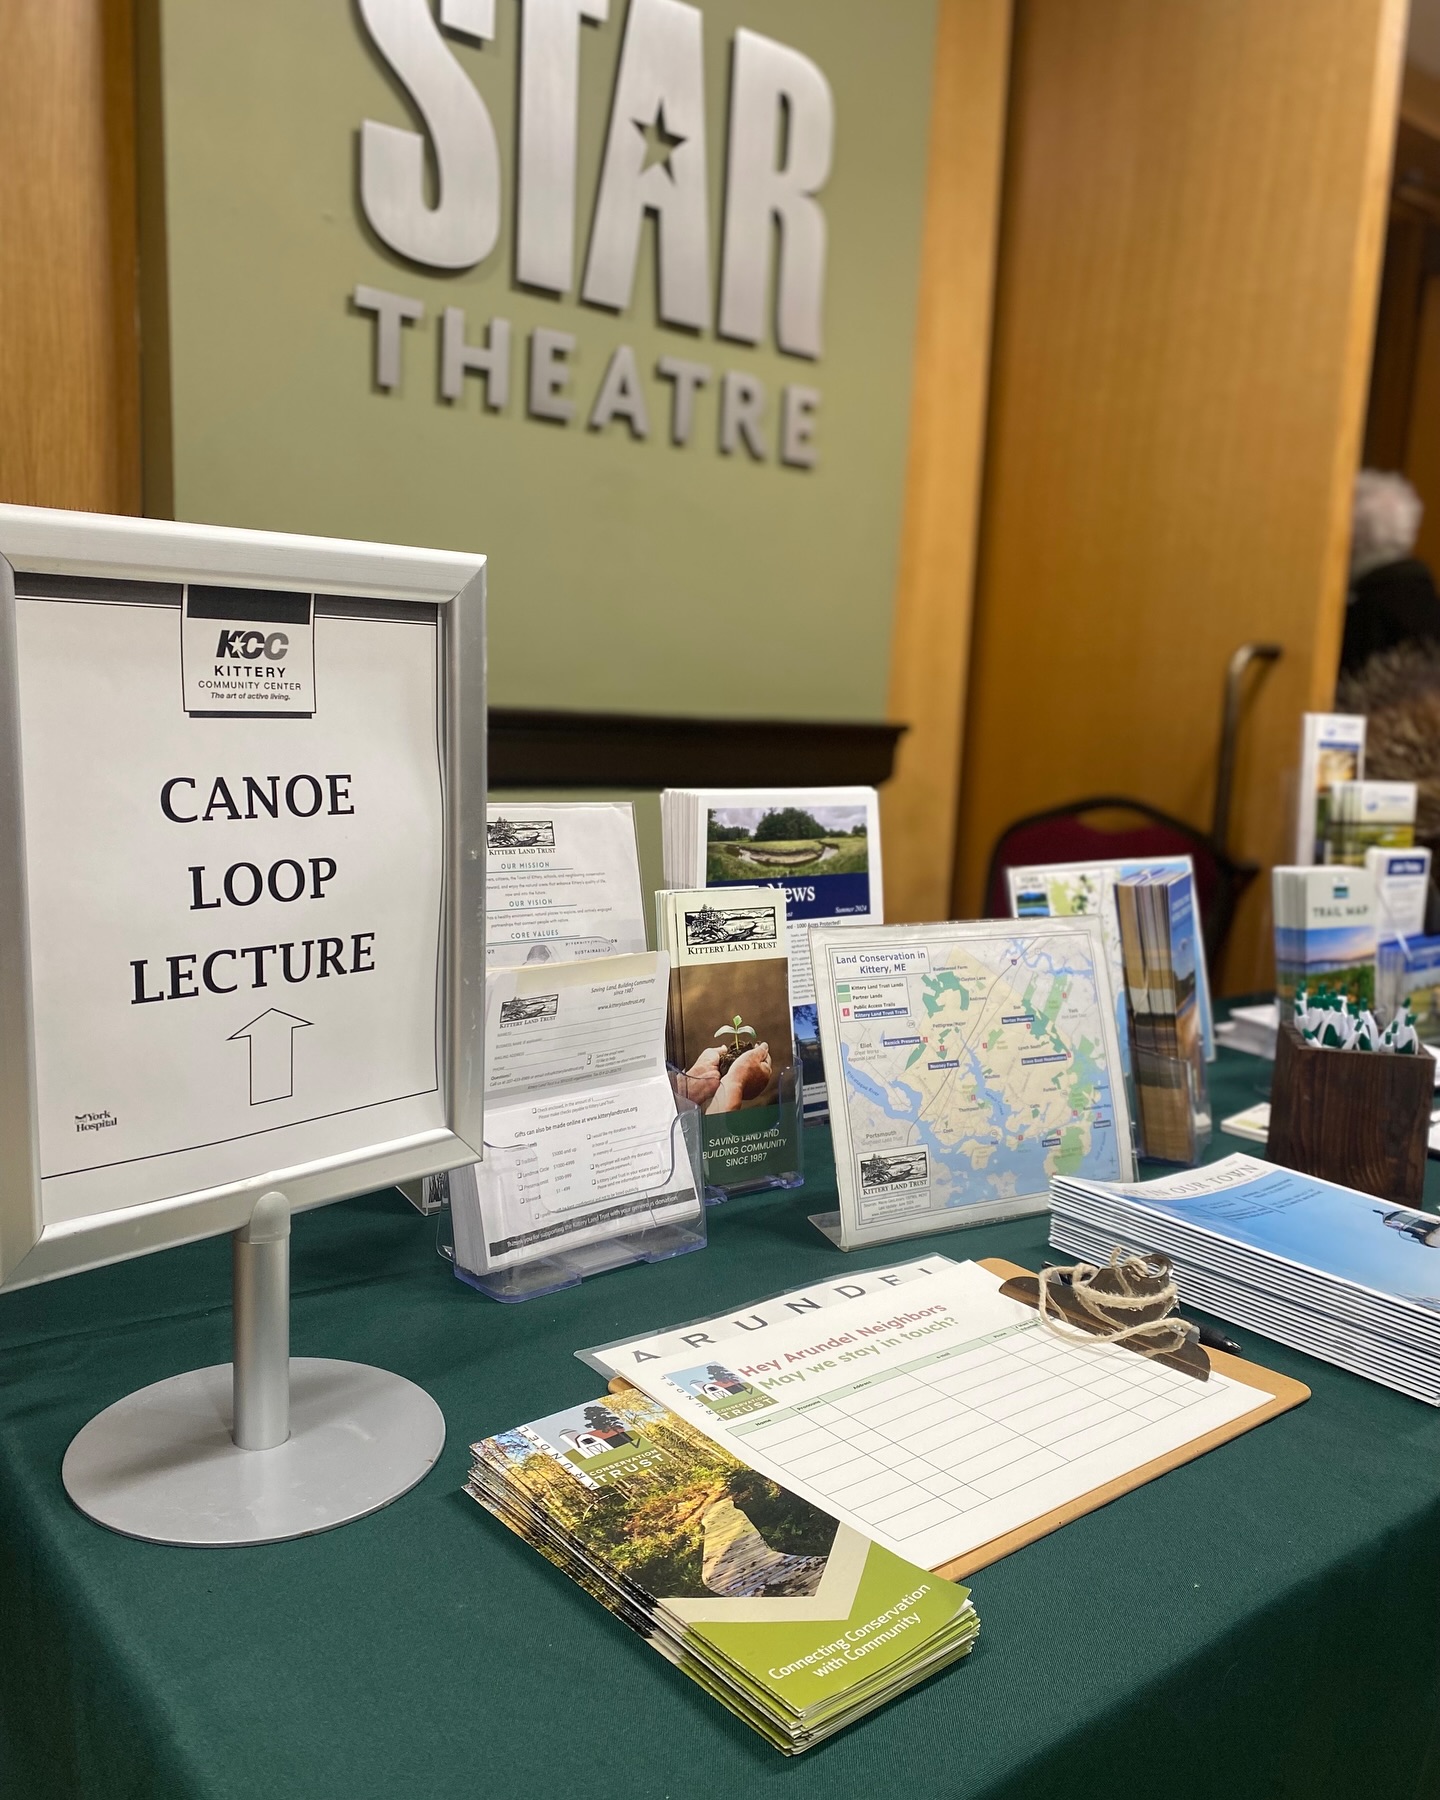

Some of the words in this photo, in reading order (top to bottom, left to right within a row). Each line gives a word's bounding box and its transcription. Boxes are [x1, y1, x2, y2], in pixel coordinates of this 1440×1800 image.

[358, 0, 833, 362] STAR
[354, 285, 819, 468] THEATRE
[216, 630, 289, 660] KCC
[214, 665, 286, 677] KITTERY
[198, 680, 259, 689] COMMUNITY
[264, 682, 301, 690] CENTER
[270, 693, 290, 701] living.
[160, 774, 355, 823] CANOE
[501, 862, 516, 870] OUR
[188, 857, 337, 910] LOOP
[767, 882, 815, 902] ews
[688, 946, 724, 955] KITTERY
[727, 944, 750, 952] LAND
[752, 941, 777, 949] TRUST
[836, 955, 856, 964] Land
[859, 952, 915, 963] Conservation
[130, 932, 375, 1004] LECTURE
[860, 965, 892, 974] Kittery,
[76, 1117, 117, 1132] Hospital
[567, 1119, 580, 1127] online
[587, 1106, 638, 1122] www.kitterylandtrust.org
[709, 1136, 739, 1147] SAVING
[741, 1132, 761, 1142] LAND
[763, 1128, 779, 1138] AND
[702, 1146, 739, 1160] BUILDING
[741, 1139, 787, 1153] COMMUNITY
[726, 1156, 748, 1167] SINCE
[750, 1152, 767, 1162] 1987
[863, 1186, 888, 1196] KITTERY
[890, 1183, 907, 1191] LAND
[910, 1180, 927, 1188] TRUST
[1170, 1182, 1208, 1194] OUR
[1206, 1164, 1259, 1185] TOWN
[540, 1226, 564, 1239] supporting
[564, 1224, 572, 1232] the
[572, 1220, 587, 1230] Kittery
[588, 1215, 599, 1224] Land
[599, 1213, 610, 1222] Trust
[610, 1210, 620, 1218] with
[620, 1207, 631, 1215] your
[738, 1359, 782, 1378] Hey
[784, 1332, 858, 1364] Arundel
[857, 1302, 948, 1337] Neighbors
[758, 1369, 807, 1391] May
[806, 1359, 838, 1374] we
[838, 1342, 881, 1364] stay
[883, 1336, 900, 1348] in
[900, 1316, 960, 1342] touch?
[660, 1376, 722, 1422] ARUNDEL
[716, 1394, 768, 1414] CONSERVATION
[720, 1399, 775, 1420] TRUST
[519, 1426, 598, 1490] ARUNDEL
[589, 1450, 658, 1476] CONSERVATION
[594, 1454, 665, 1484] TRUST
[768, 1638, 850, 1680] Connecting
[844, 1584, 932, 1643] Conservation
[812, 1654, 848, 1678] with
[844, 1612, 922, 1662] Community
